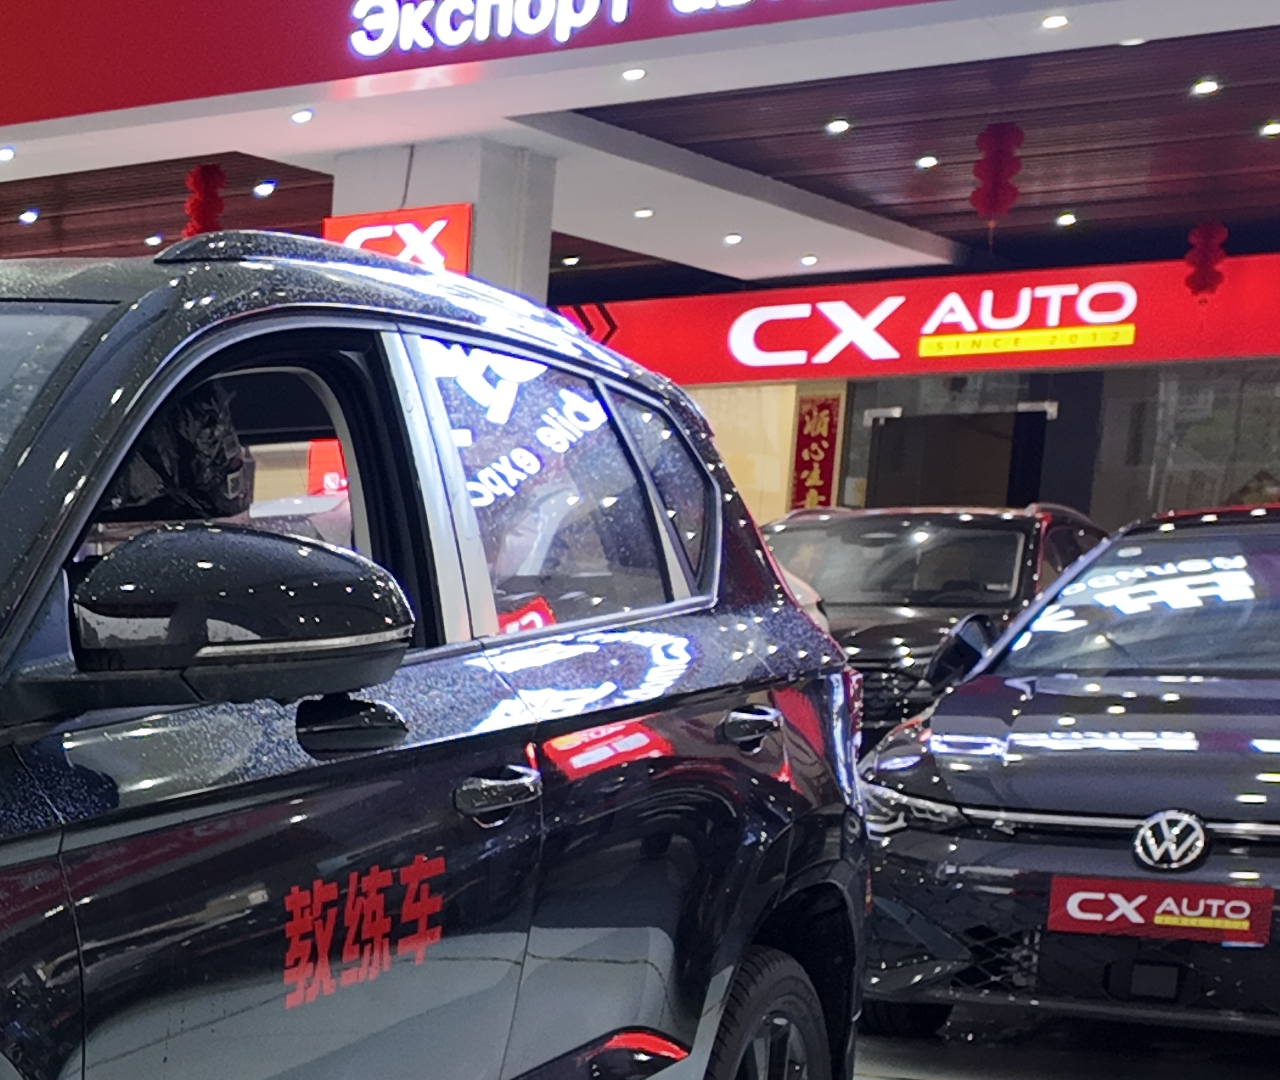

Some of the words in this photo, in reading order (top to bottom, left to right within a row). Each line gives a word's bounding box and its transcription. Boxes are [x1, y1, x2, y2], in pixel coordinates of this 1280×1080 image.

[349, 0, 631, 57] Экспорт
[728, 296, 906, 367] CX
[920, 281, 1138, 335] AUTO
[283, 853, 446, 1010] 教练车
[1066, 891, 1148, 924] CX
[1155, 897, 1251, 920] AUTO
